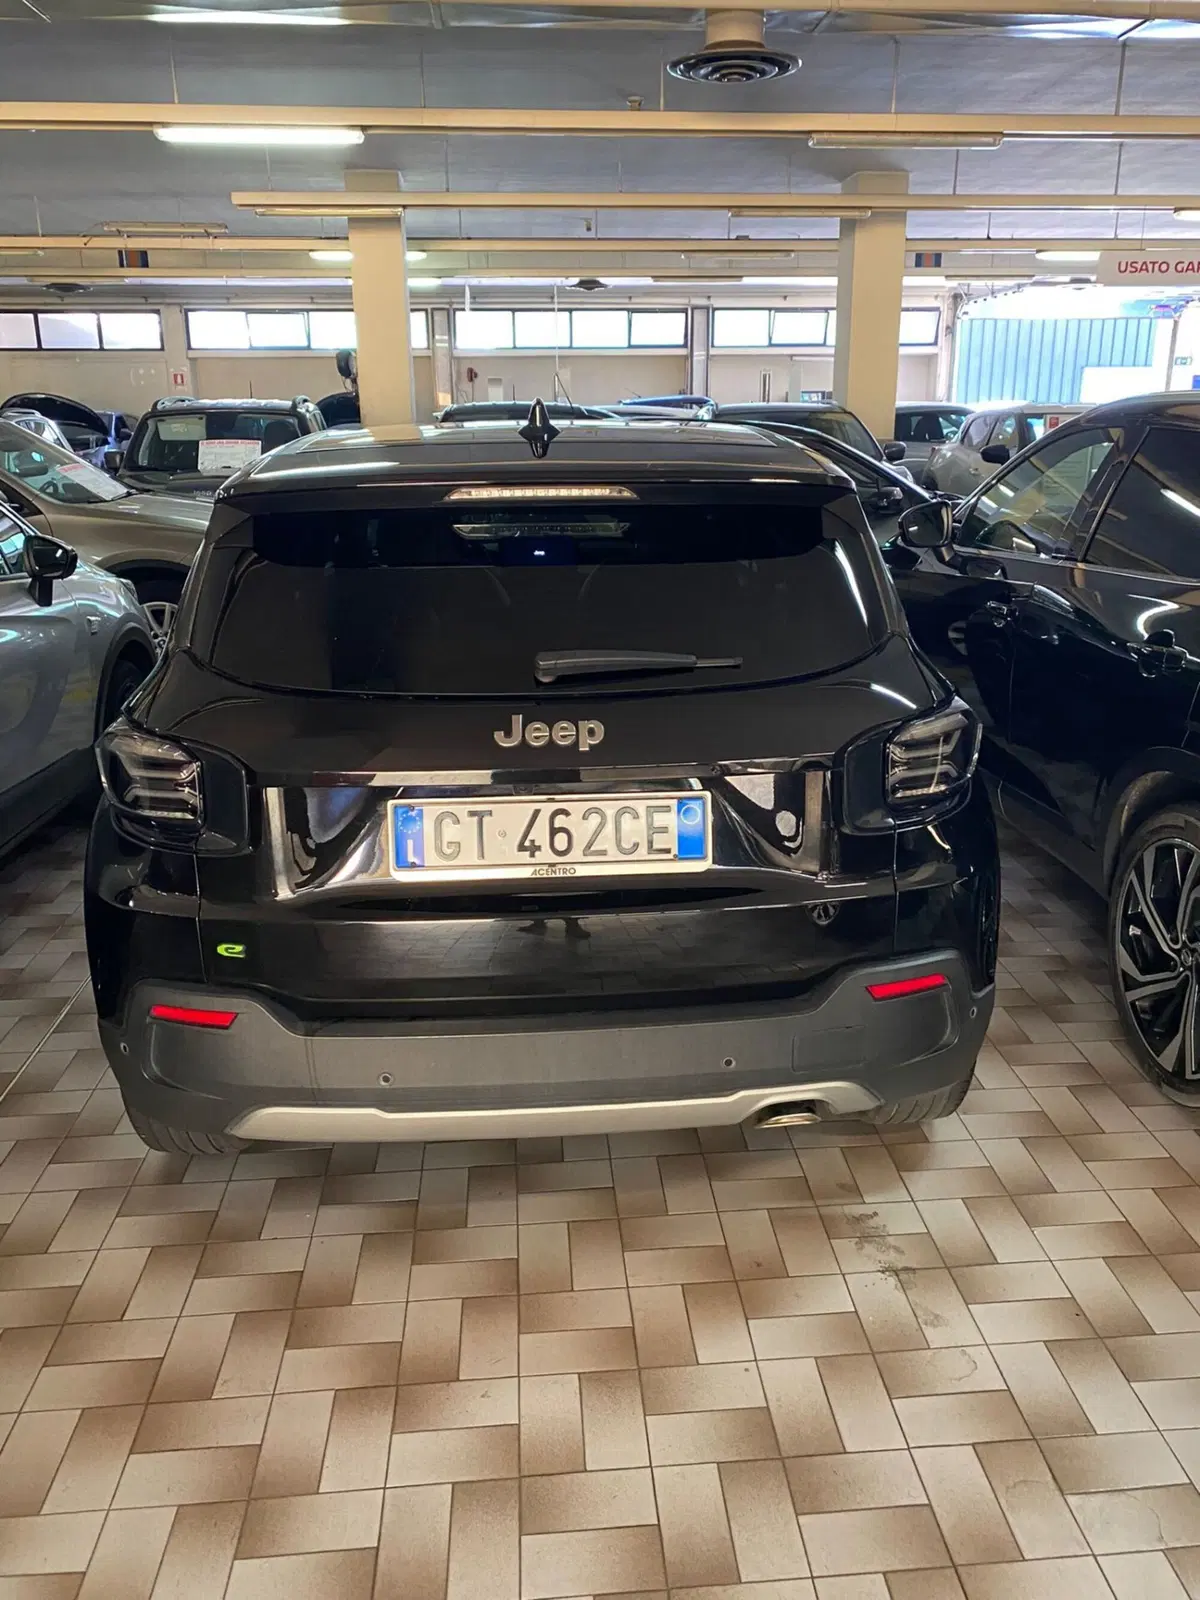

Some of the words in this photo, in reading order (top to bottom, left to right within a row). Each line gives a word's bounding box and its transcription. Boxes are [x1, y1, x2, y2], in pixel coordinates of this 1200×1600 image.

[1117, 260, 1170, 274] USATO
[493, 714, 605, 751] Jeep
[433, 809, 493, 862] GT
[516, 805, 672, 859] 462CE
